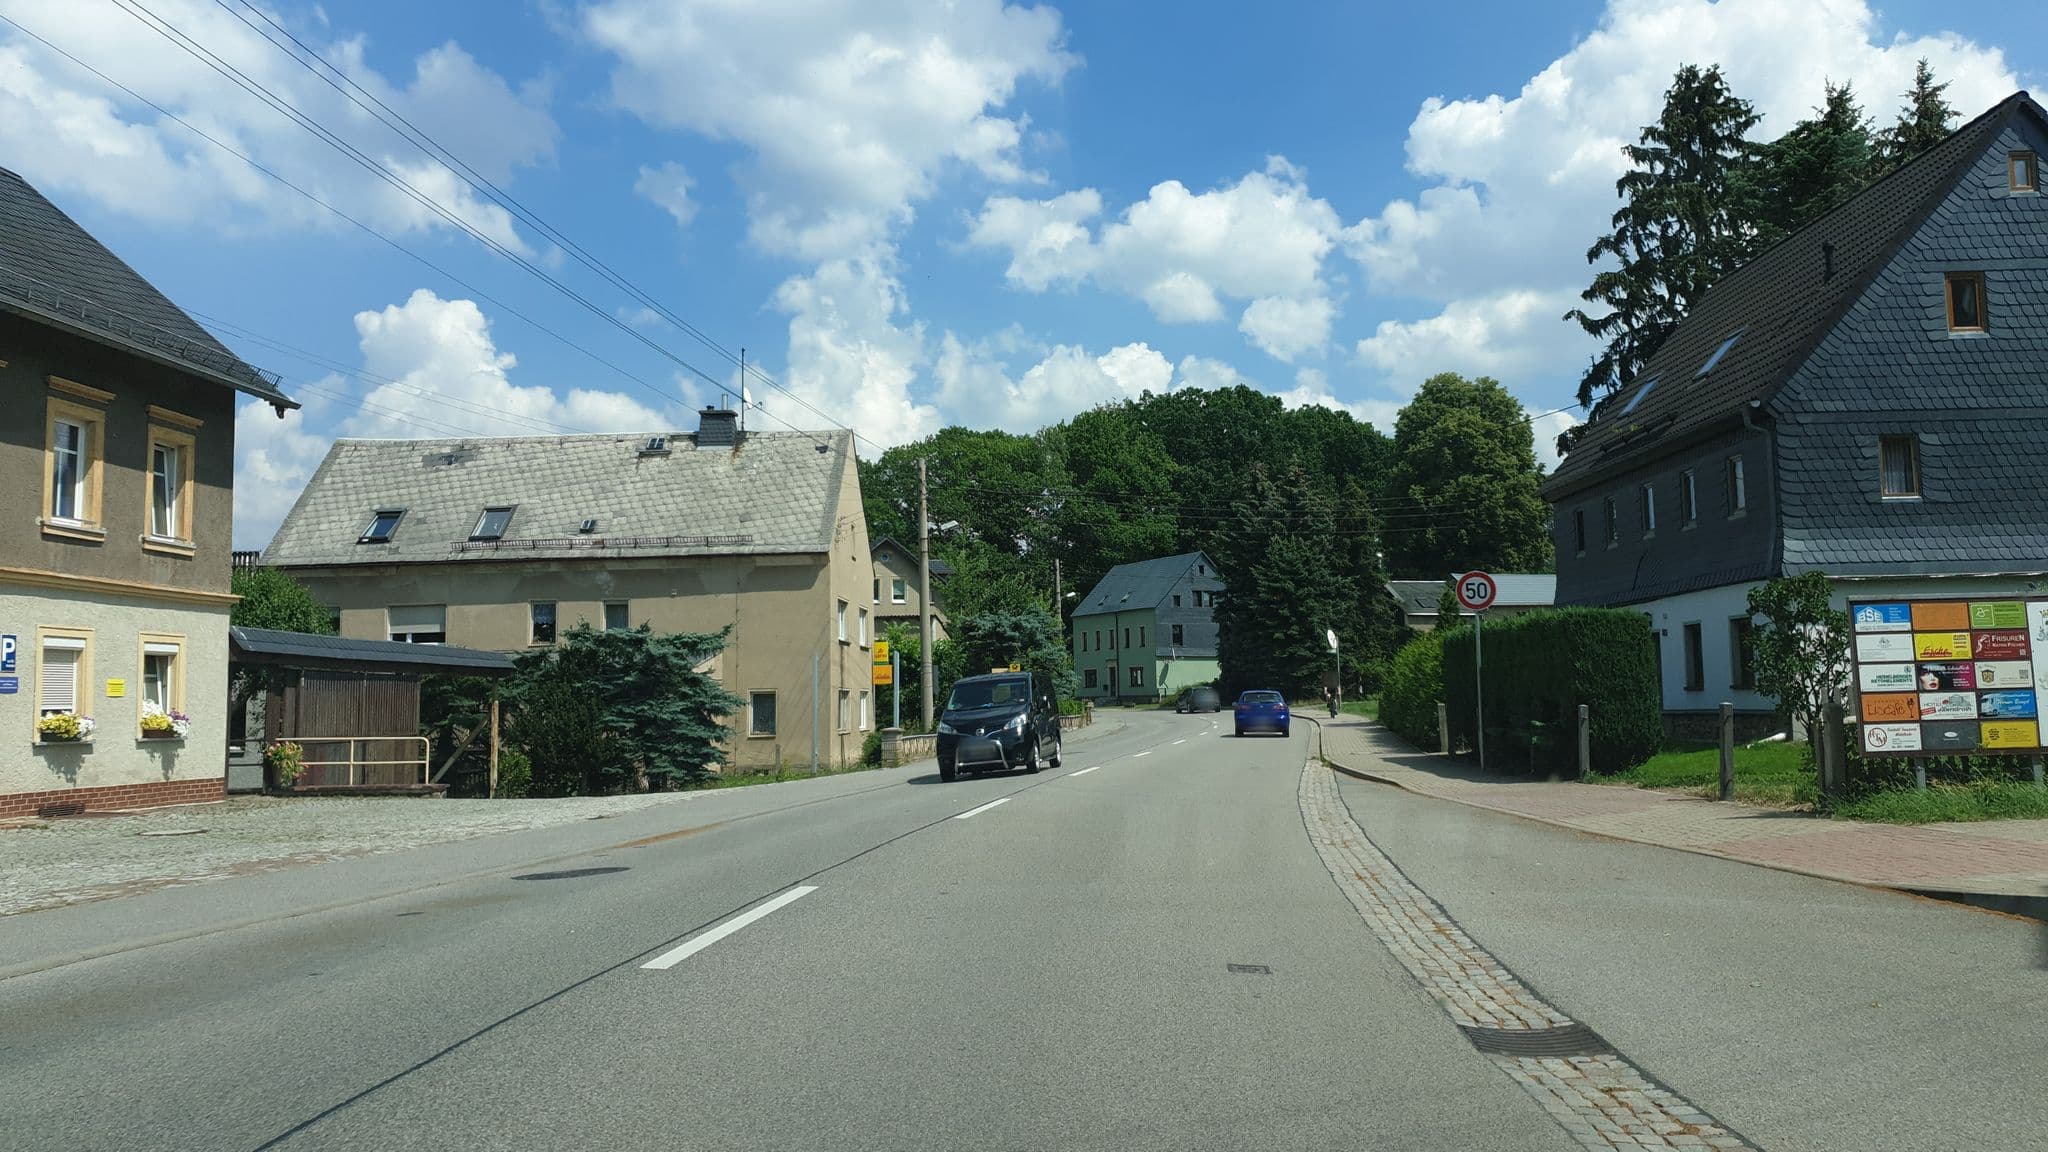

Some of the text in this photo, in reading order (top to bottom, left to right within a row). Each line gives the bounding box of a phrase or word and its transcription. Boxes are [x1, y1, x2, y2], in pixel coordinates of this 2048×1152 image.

[1466, 582, 1488, 600] 50
[1991, 634, 2025, 642] FRISUREN
[2, 637, 15, 662] P
